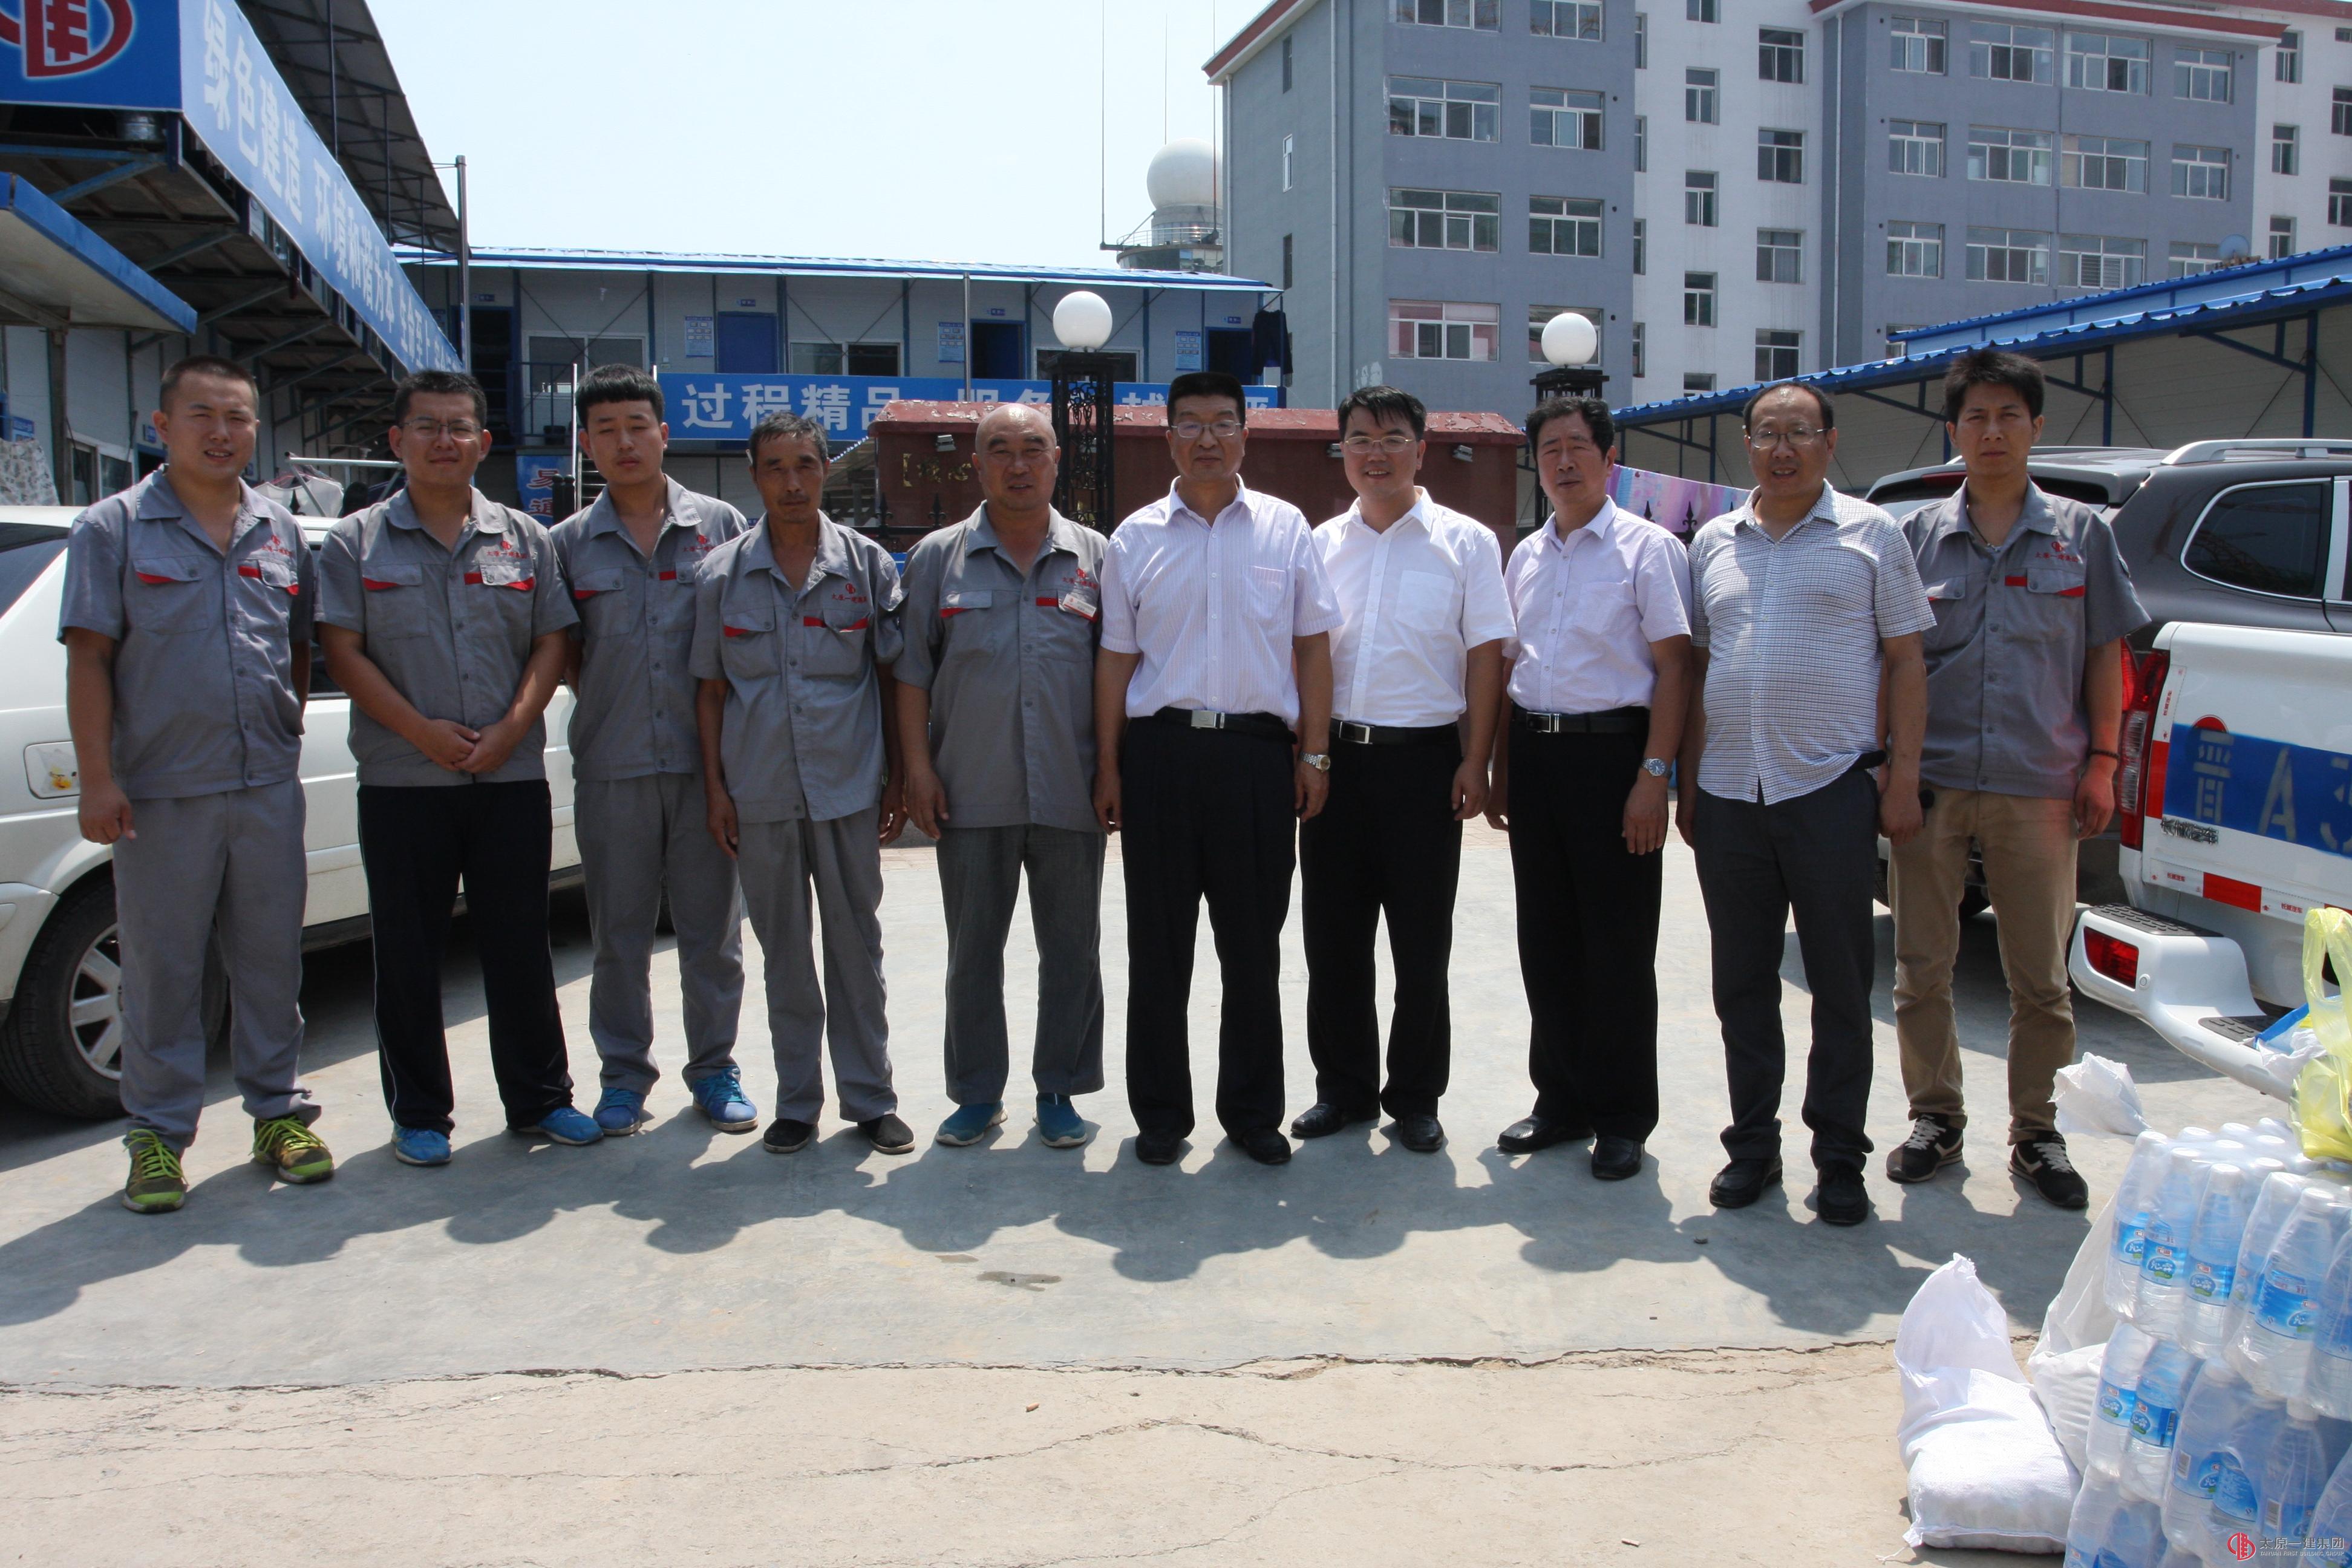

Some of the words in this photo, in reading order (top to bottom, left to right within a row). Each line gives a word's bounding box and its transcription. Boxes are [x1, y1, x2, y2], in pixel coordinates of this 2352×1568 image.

[203, 0, 302, 226] 绿色建造
[682, 383, 900, 431] 过程精品
